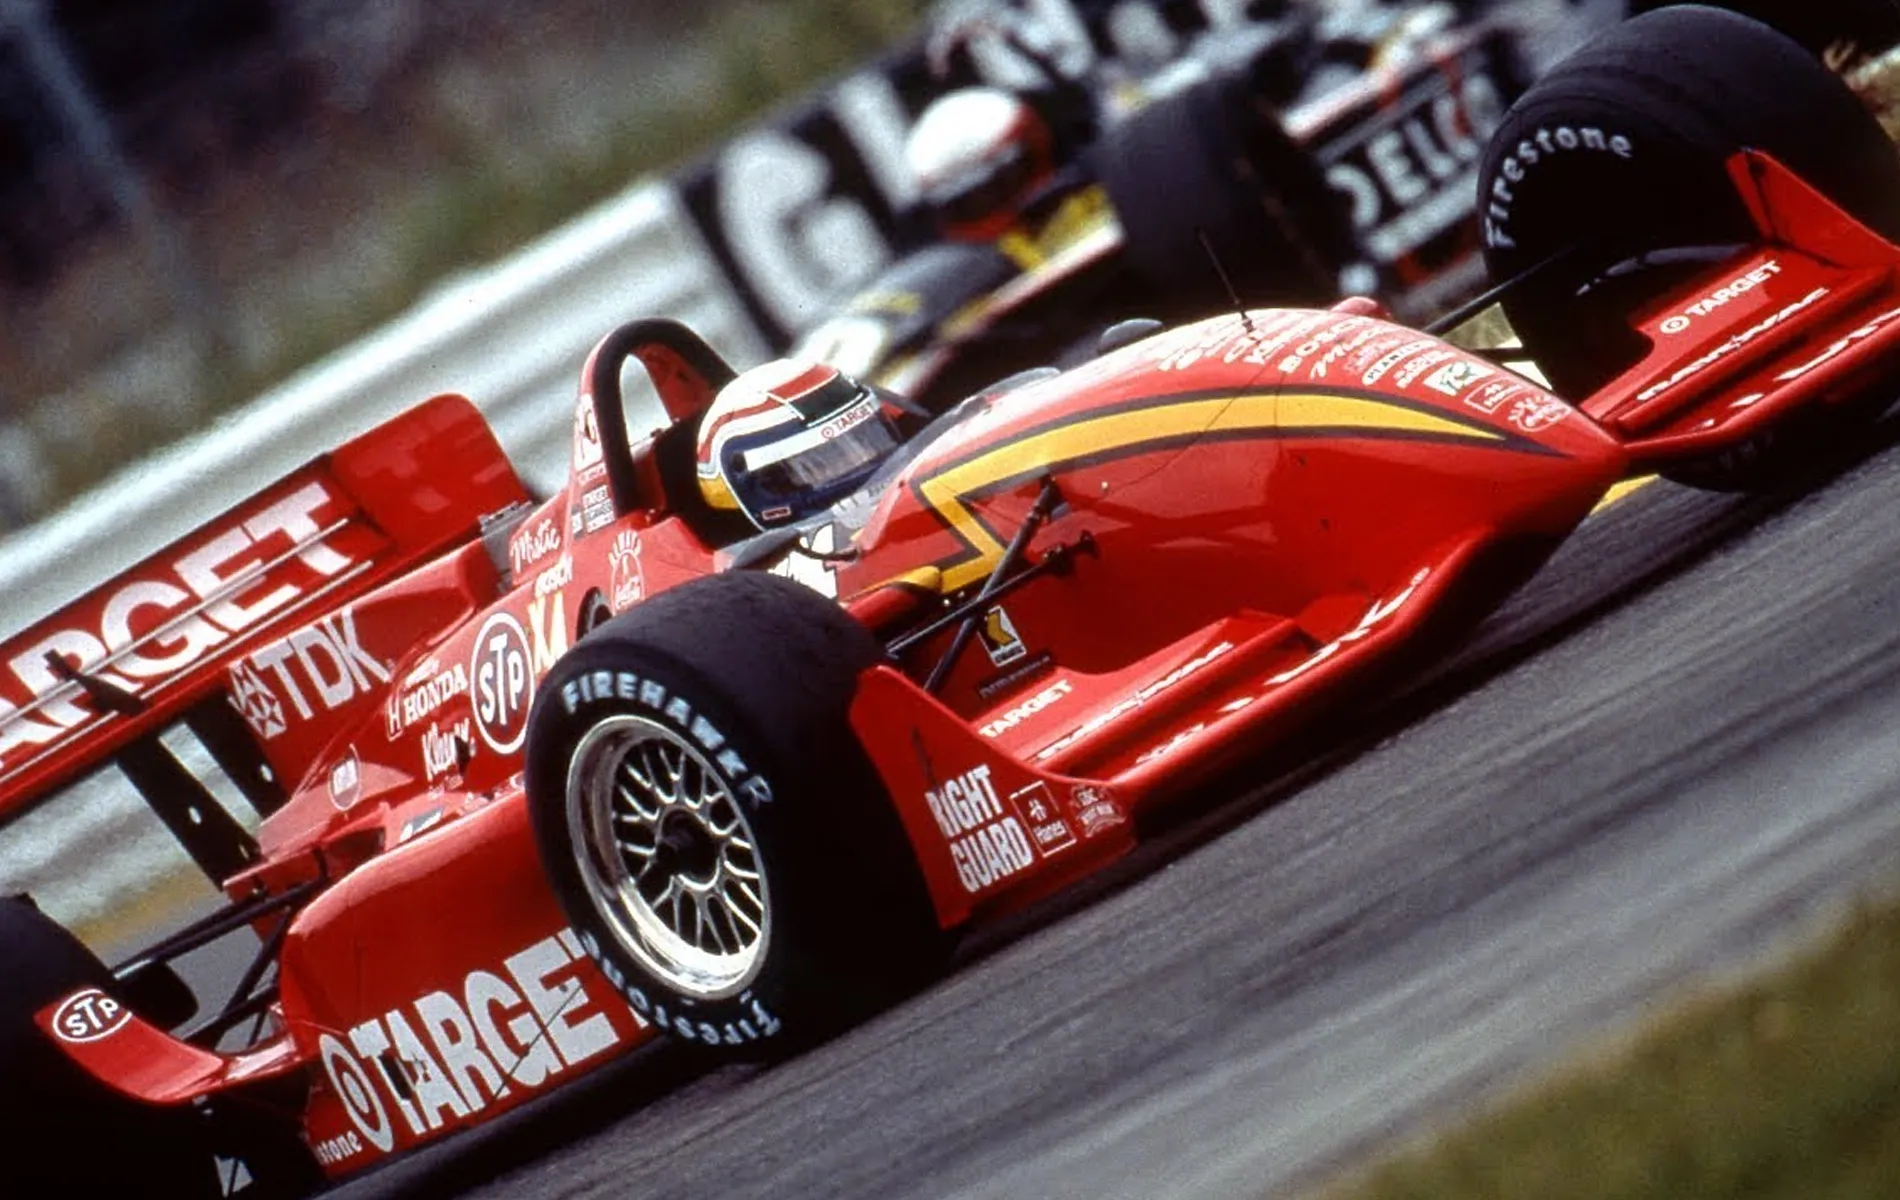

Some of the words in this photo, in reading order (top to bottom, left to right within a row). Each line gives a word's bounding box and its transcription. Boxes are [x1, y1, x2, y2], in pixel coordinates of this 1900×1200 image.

[1485, 126, 1633, 249] Firestone
[1687, 260, 1781, 316] TARGET
[252, 606, 393, 720] TDK
[403, 663, 468, 726] HONDA
[479, 633, 524, 726] STP
[562, 671, 748, 785] FIREHAWK
[978, 679, 1073, 737] TARGET
[924, 764, 1003, 837] RIGHT
[950, 817, 1034, 892] GUARD
[65, 997, 119, 1036] STP
[317, 1129, 363, 1166] stone
